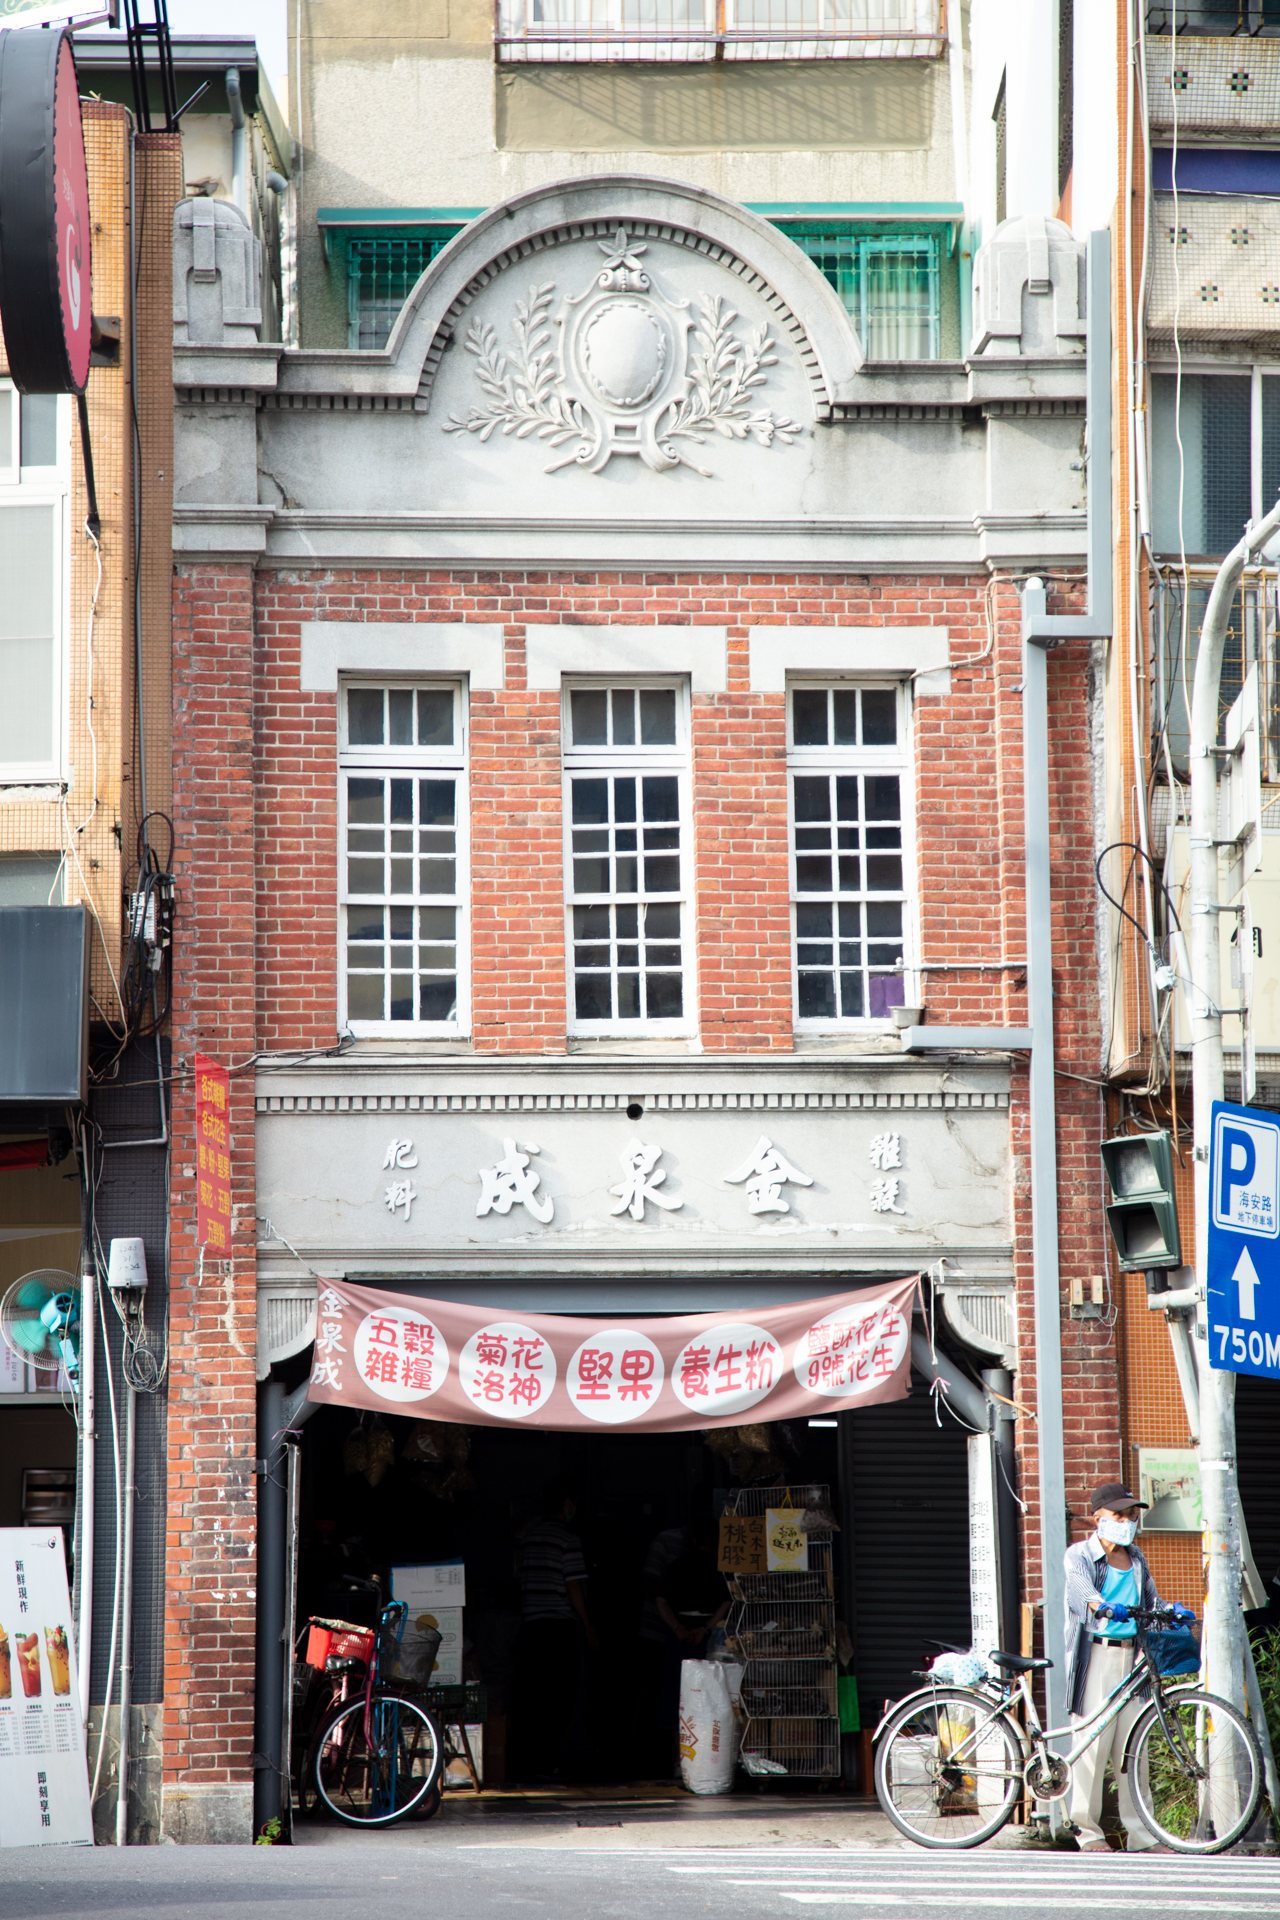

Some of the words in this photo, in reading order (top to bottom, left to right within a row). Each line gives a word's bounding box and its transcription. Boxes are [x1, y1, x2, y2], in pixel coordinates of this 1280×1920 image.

[201, 1110, 227, 1146] 各式花生
[1220, 1126, 1257, 1217] P
[1237, 1211, 1274, 1228] 地下停車場
[1239, 1190, 1272, 1212] 海安路
[309, 1287, 351, 1392] 金泉成
[475, 1332, 545, 1371] 菊花
[1213, 1323, 1280, 1370] 750M
[472, 1369, 542, 1407] 洛神
[575, 1348, 655, 1402] 堅果
[679, 1339, 777, 1399] 養生粉
[807, 1343, 896, 1389] 9號花生
[722, 1522, 748, 1566] 桃膠
[748, 1520, 765, 1572] 白木耳
[14, 1559, 29, 1614] 新鮮現作
[37, 1771, 51, 1827] 即刻享用
